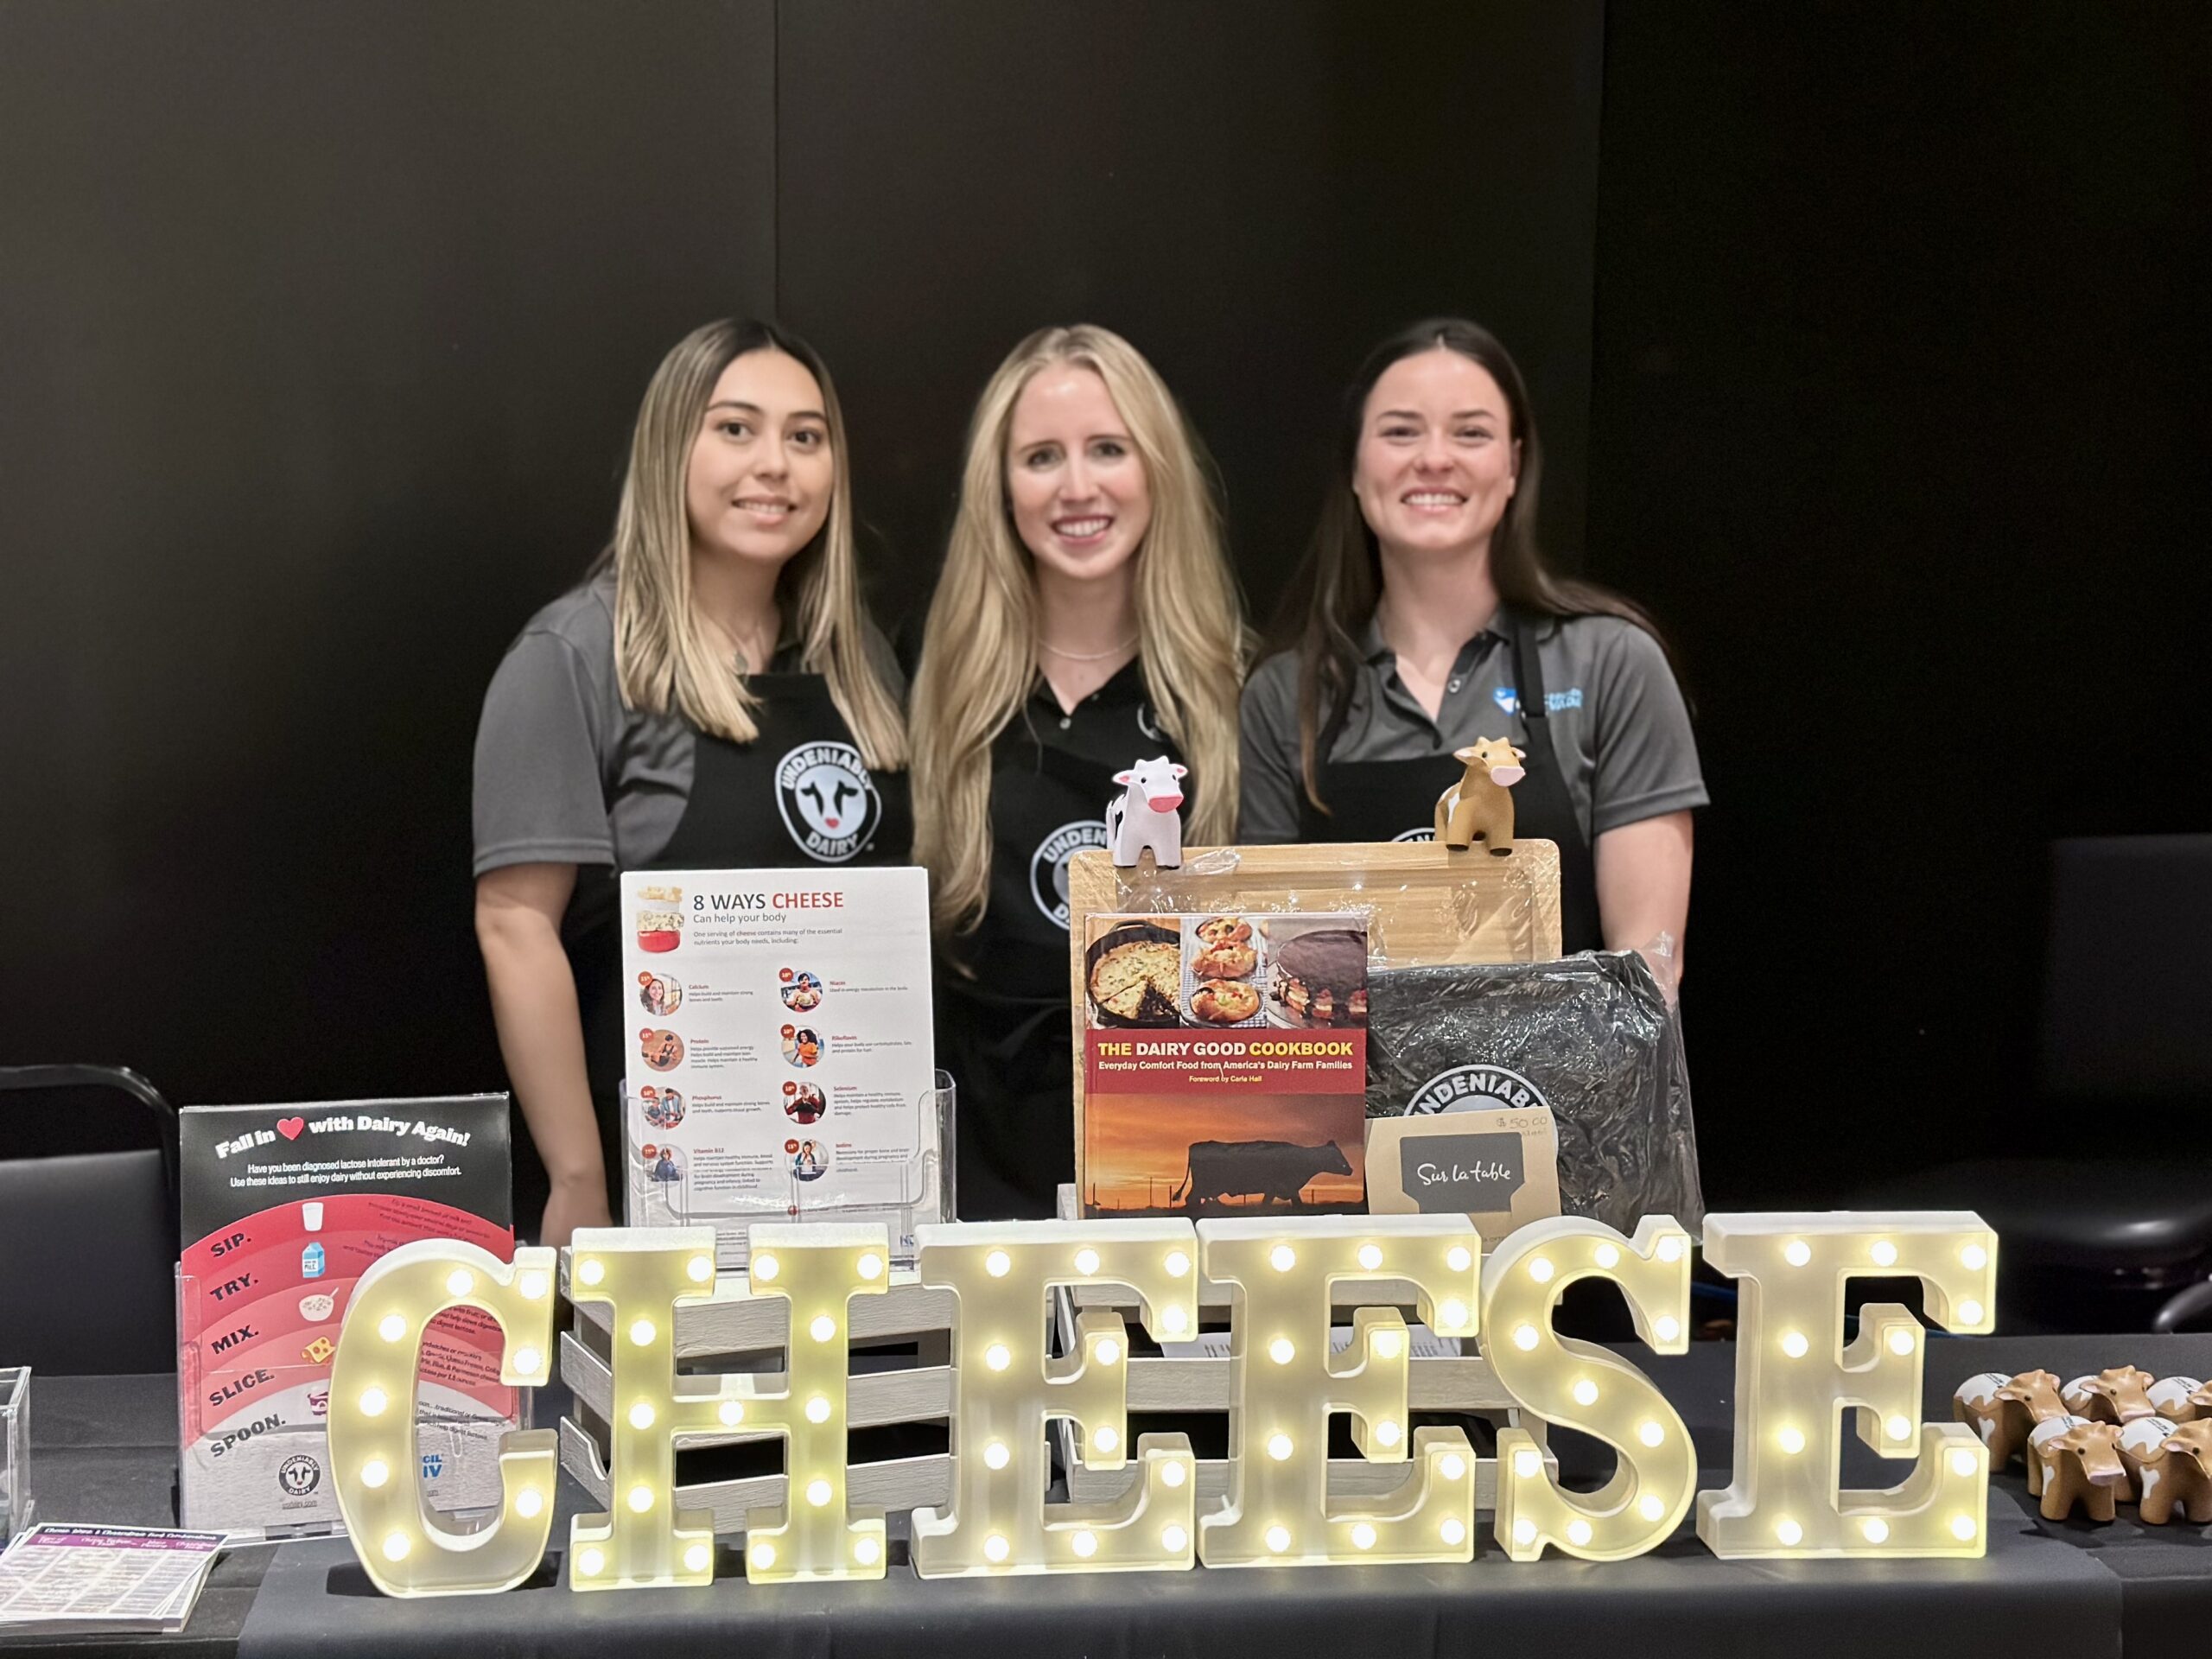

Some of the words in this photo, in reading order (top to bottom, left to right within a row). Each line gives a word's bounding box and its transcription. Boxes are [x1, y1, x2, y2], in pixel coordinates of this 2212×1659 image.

[806, 831, 858, 855] DAIRY
[693, 894, 704, 911] 8
[710, 893, 766, 910] WAYS
[772, 892, 843, 908] CHEESE
[693, 914, 711, 923] Can
[715, 912, 735, 924] help
[738, 914, 760, 924] your
[762, 912, 786, 923] body
[1097, 1042, 1132, 1056] THE
[1136, 1042, 1191, 1056] DAIRY
[1193, 1042, 1246, 1056] GOOD
[1249, 1042, 1353, 1056] COOKBOOK
[1098, 1061, 1137, 1071] Everyday
[1139, 1061, 1174, 1070] Comfort
[1176, 1061, 1196, 1070] Food
[1201, 1061, 1220, 1070] from
[1267, 1061, 1290, 1071] Dairy
[1316, 1060, 1353, 1069] Families
[1414, 1073, 1538, 1115] NDENIAB
[215, 1133, 255, 1159] Fall
[254, 1130, 276, 1146] in
[308, 1116, 354, 1134] with
[357, 1116, 411, 1136] Dairy
[411, 1121, 471, 1147] Again!
[230, 1177, 245, 1187] Use
[246, 1176, 266, 1185] these
[268, 1175, 288, 1185] ideas
[289, 1175, 296, 1185] to
[297, 1173, 309, 1184] still
[310, 1173, 330, 1184] enjoy
[331, 1173, 348, 1183] dairy
[349, 1171, 375, 1181] without
[377, 1169, 422, 1180] experiencing
[423, 1166, 462, 1177] discomfort.
[247, 1163, 267, 1173] Have
[268, 1165, 282, 1175] you
[283, 1163, 301, 1172] been
[302, 1160, 340, 1172] diagnosed
[340, 1159, 366, 1169] lactose
[367, 1157, 400, 1167] intolerant
[401, 1156, 410, 1166] by
[417, 1154, 444, 1165] doctor?
[1417, 1163, 1448, 1185] Sur
[1452, 1164, 1469, 1181] la
[1470, 1160, 1511, 1182] table
[210, 1232, 251, 1257] SIP.
[209, 1273, 258, 1301] TRY.
[211, 1324, 259, 1355] MIX.
[209, 1369, 275, 1407] SLICE.
[327, 1211, 1999, 1599] CHEESE
[210, 1413, 286, 1458] SPOON.
[281, 1456, 320, 1473] UNDENIABLY
[422, 1453, 442, 1463] CIL
[289, 1485, 310, 1495] DAIRY
